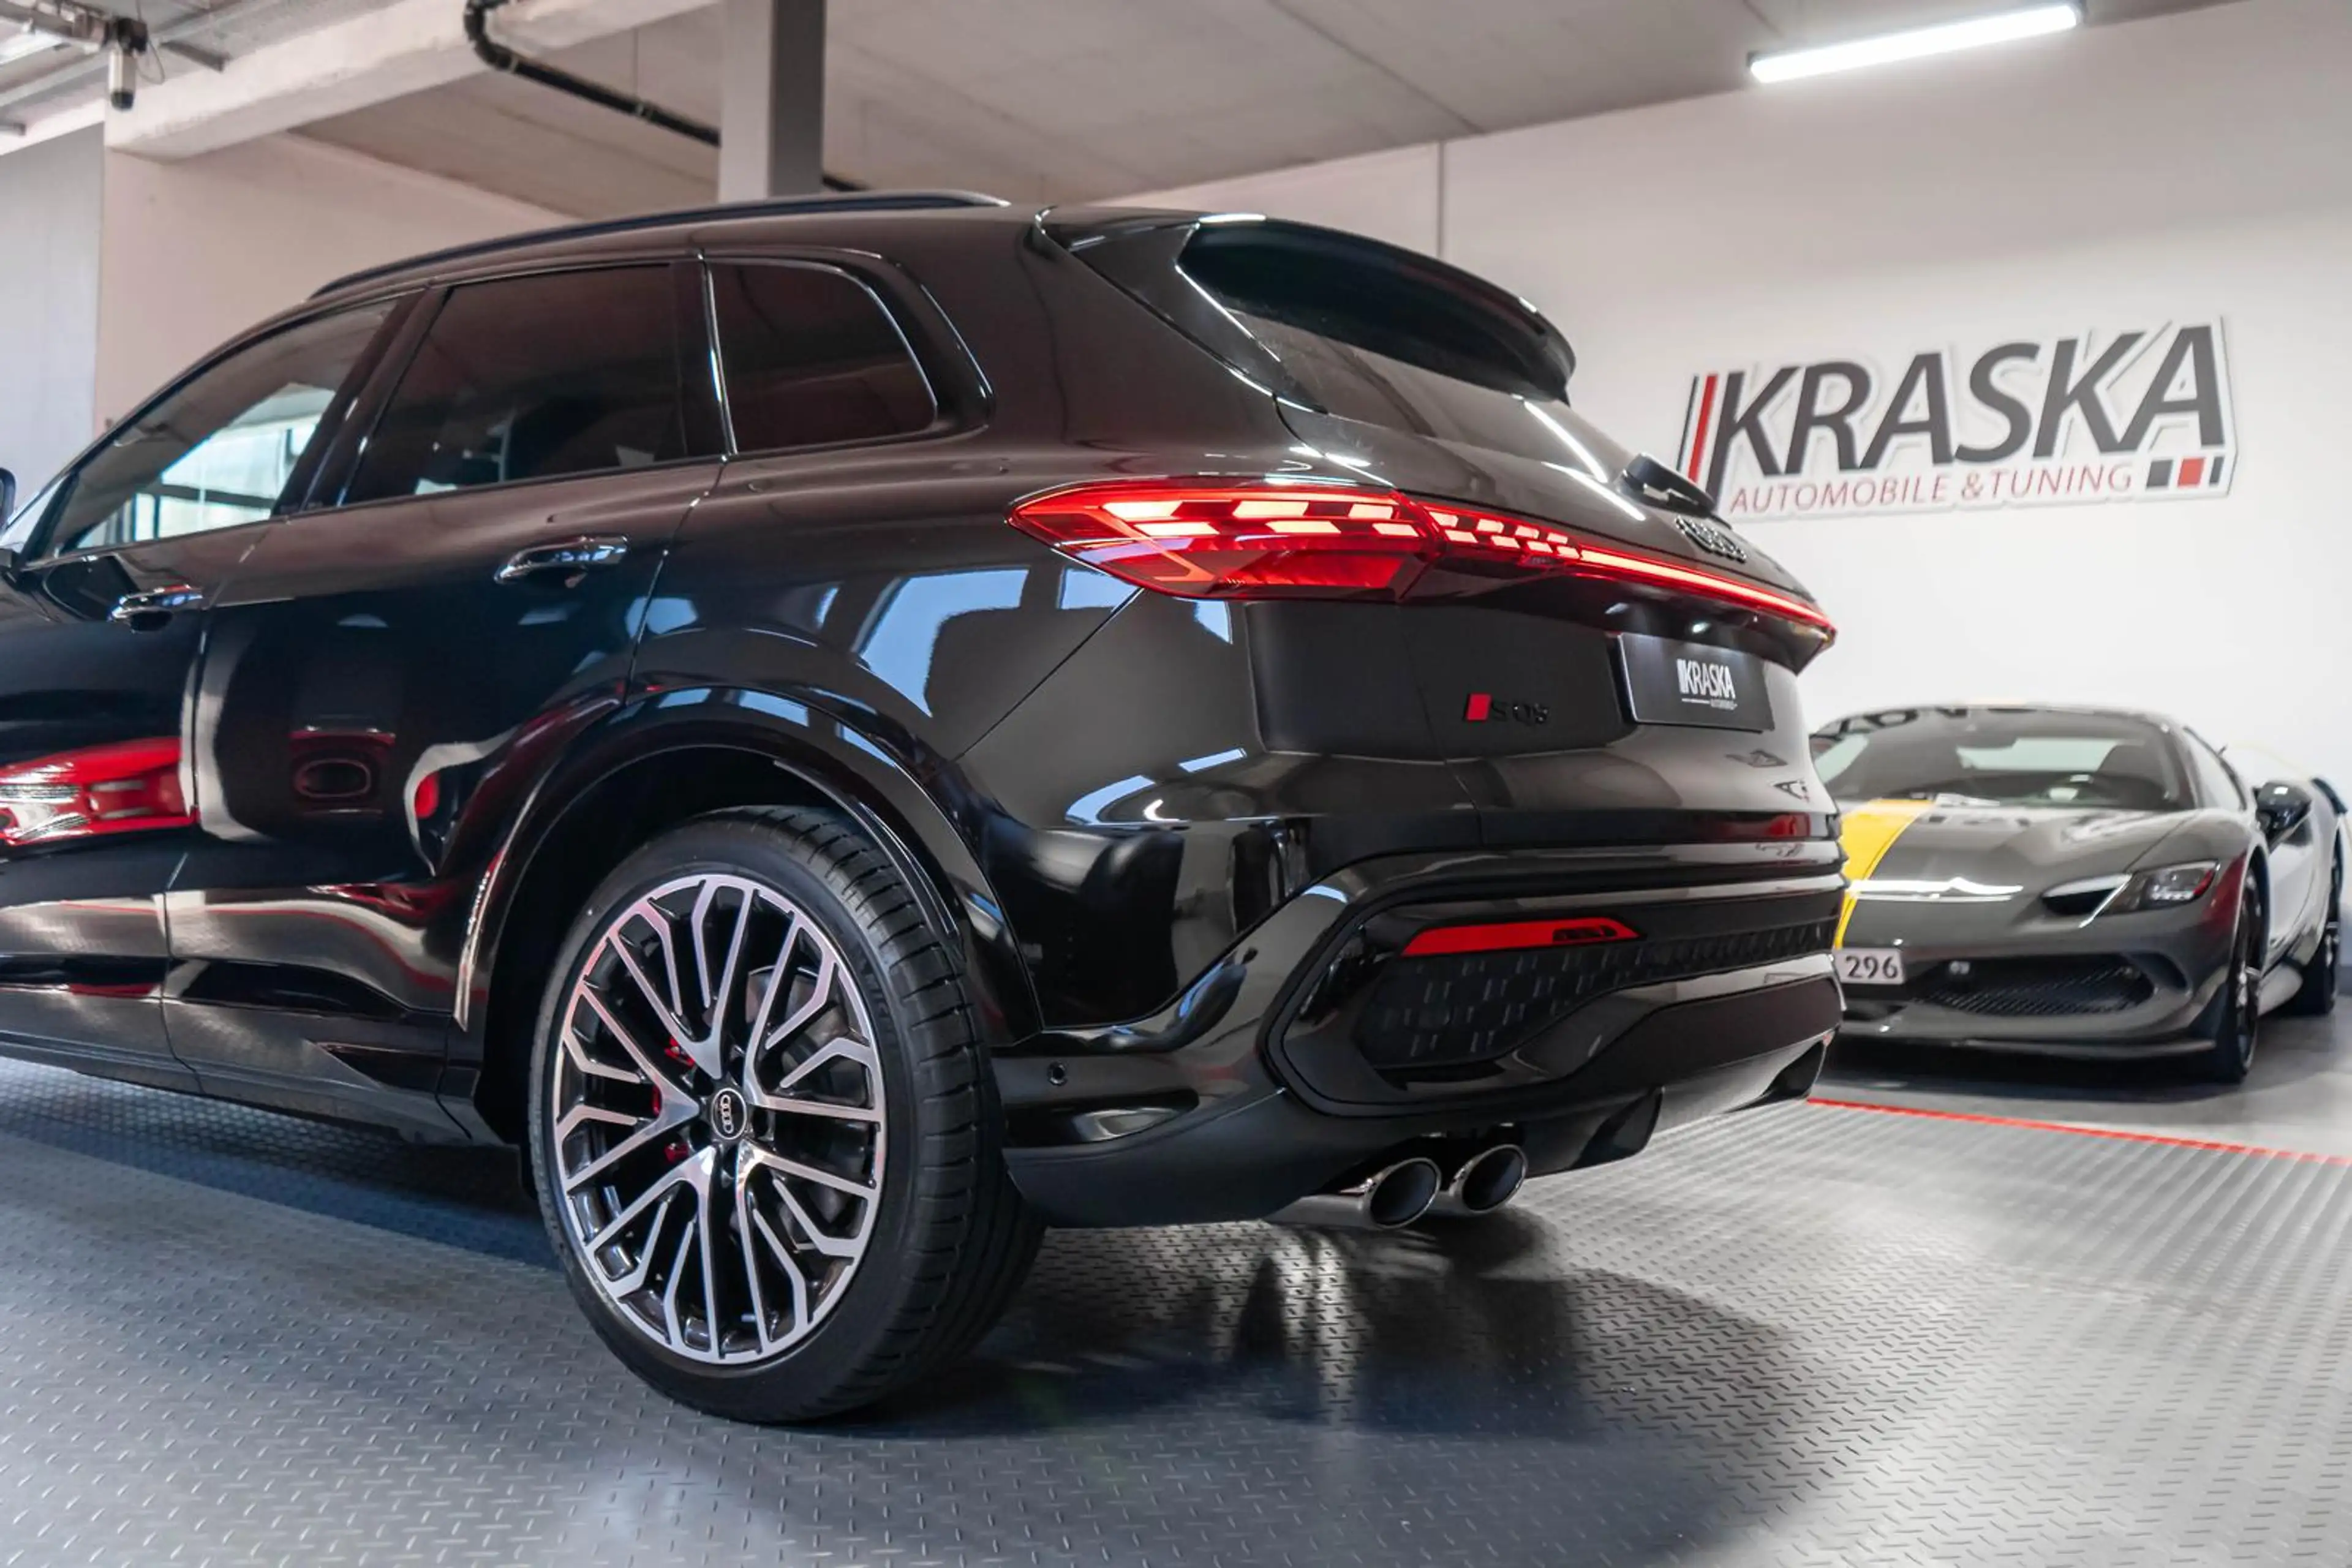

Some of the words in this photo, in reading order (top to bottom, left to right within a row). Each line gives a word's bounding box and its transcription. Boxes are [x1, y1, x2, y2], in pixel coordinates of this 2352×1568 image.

[1706, 325, 2225, 513] KRASKA
[1730, 475, 1950, 514] AUTOMOBILE
[1682, 660, 1736, 700] KRASKA
[1845, 955, 1898, 979] 296
